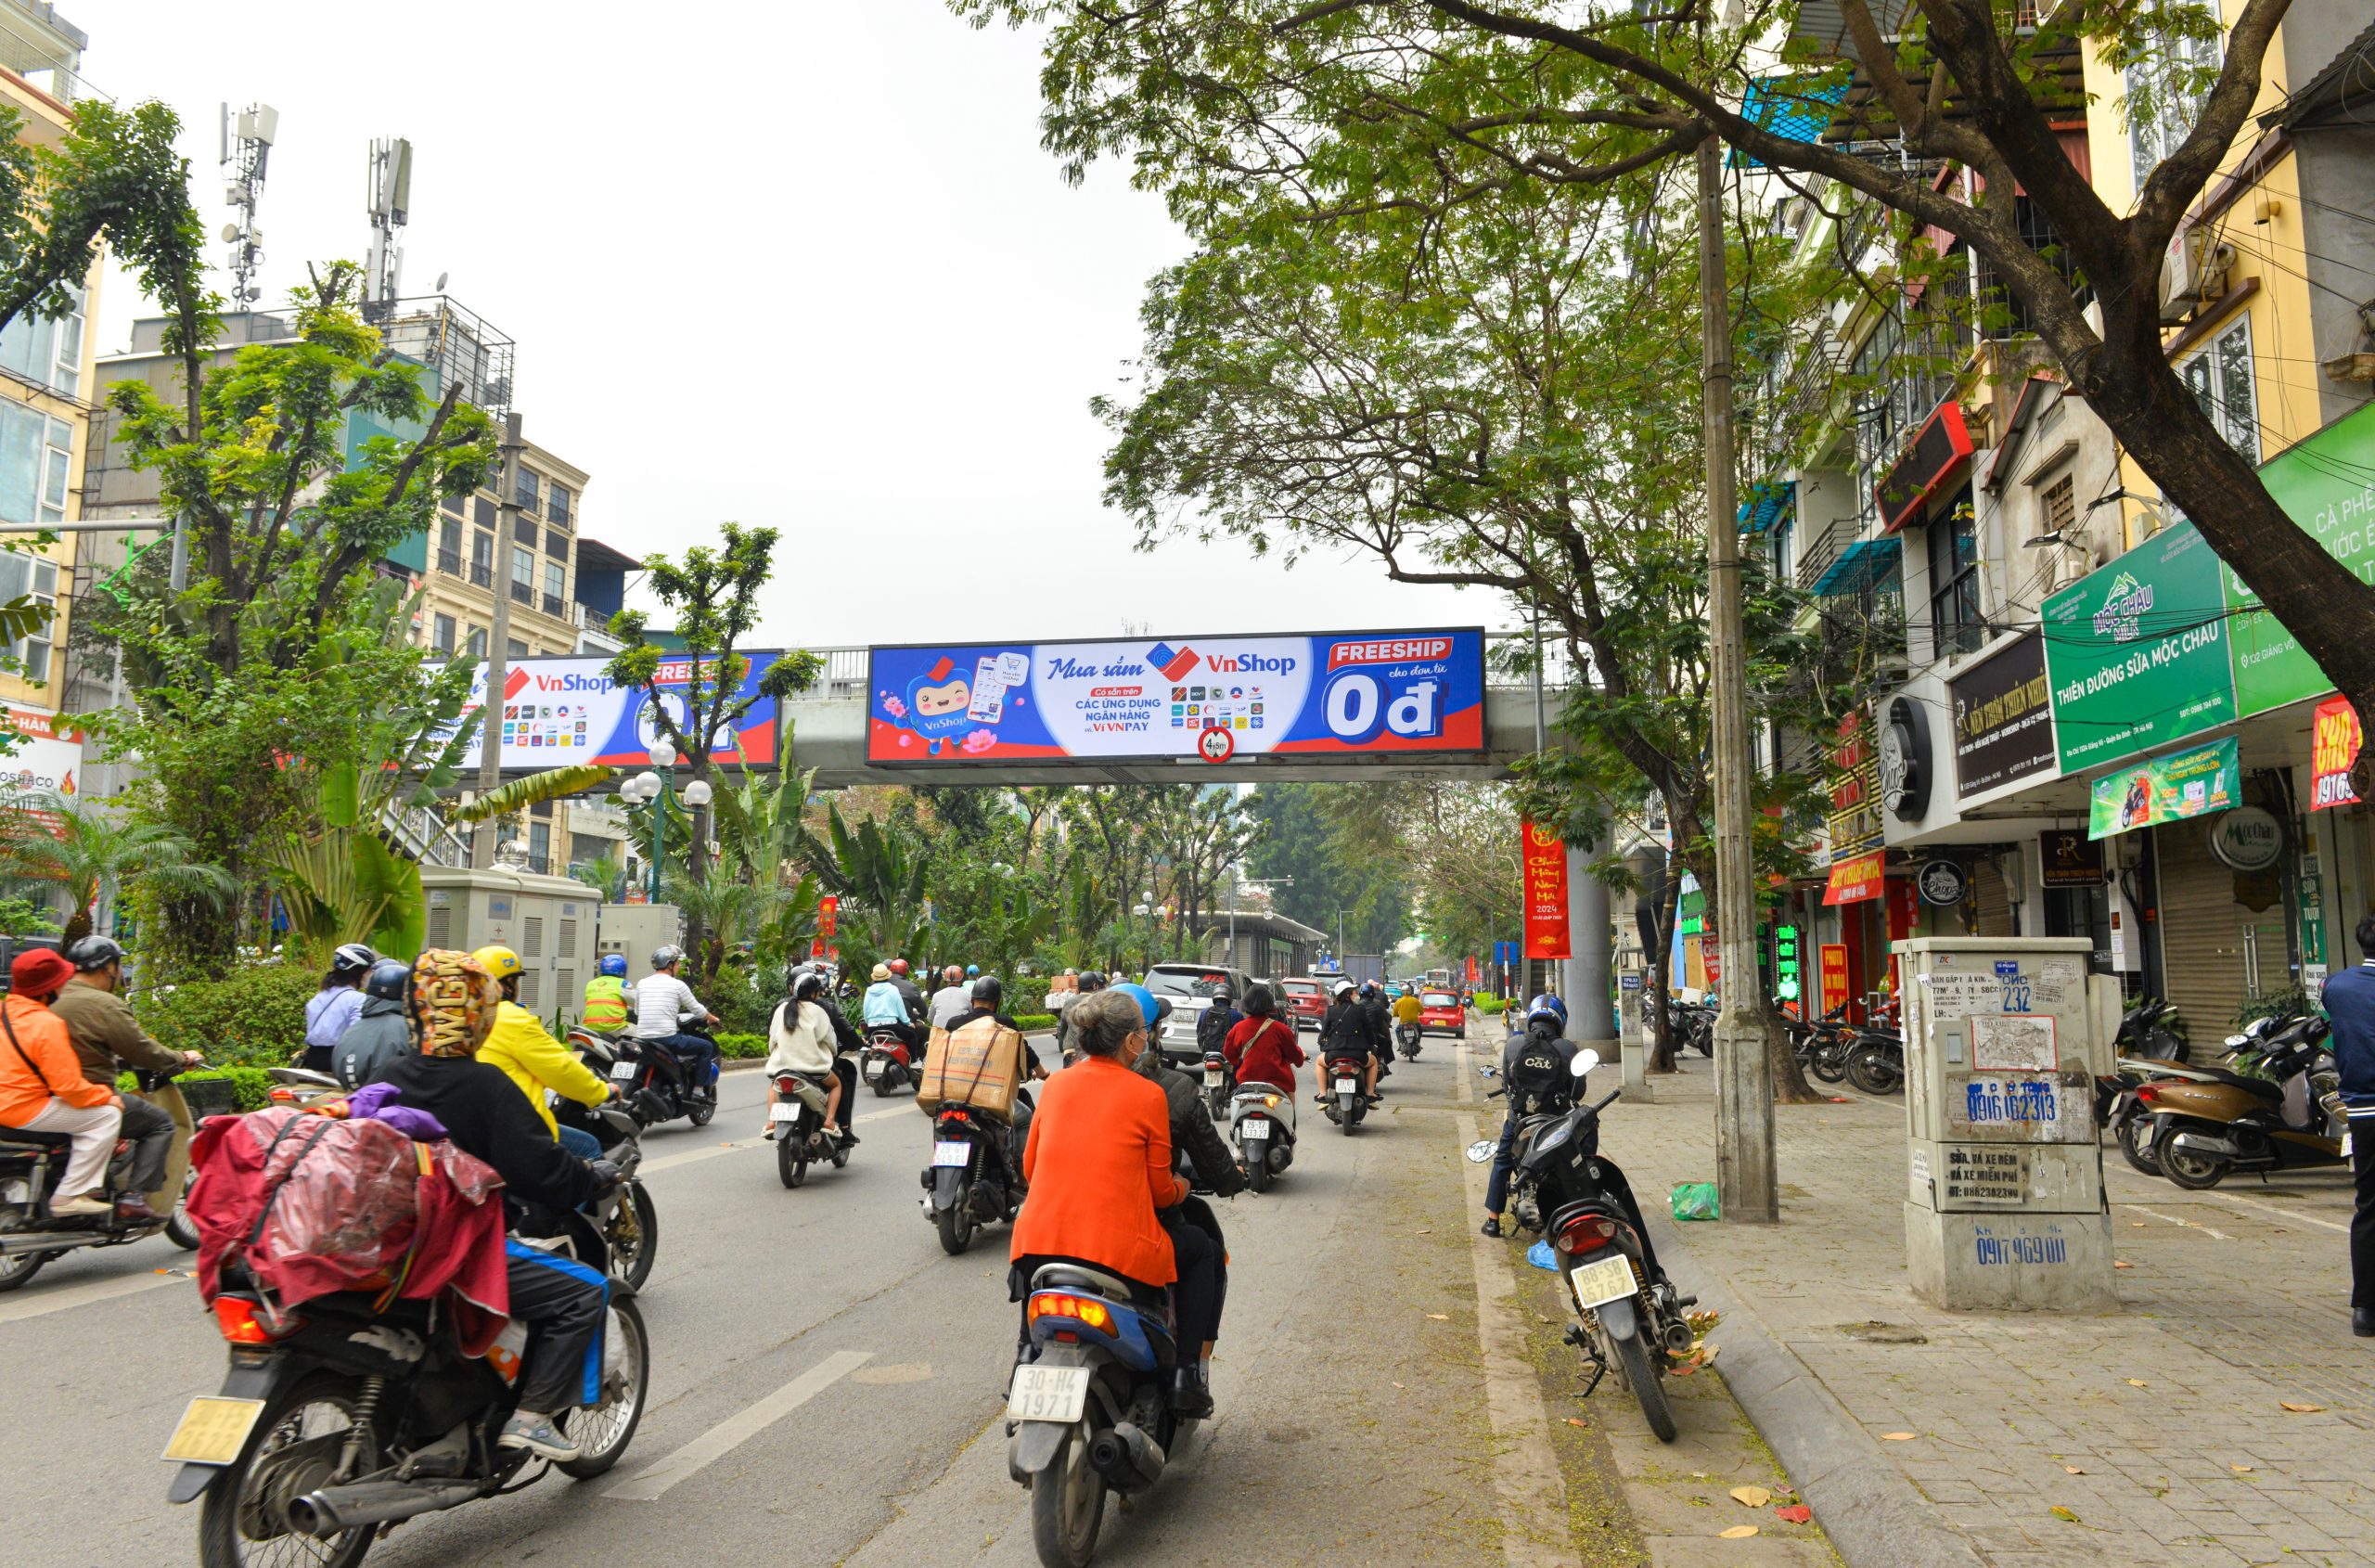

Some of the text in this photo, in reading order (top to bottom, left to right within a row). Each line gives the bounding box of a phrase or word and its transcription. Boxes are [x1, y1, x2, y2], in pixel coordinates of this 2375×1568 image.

[2316, 503, 2339, 534] CÀ
[2093, 603, 2119, 636] MỘC
[2120, 585, 2153, 621] CHÂU
[1336, 639, 1447, 662] FREESHIP
[1047, 657, 1098, 680] Mua
[1206, 654, 1296, 676] VnShop
[1389, 665, 1408, 678] cho
[2057, 679, 2086, 706] THIÊN
[2086, 662, 2125, 695] ĐƯỜNG
[2125, 651, 2150, 678] SỮA
[2151, 638, 2180, 669] MỘC
[536, 674, 614, 696] VnShop
[1076, 698, 1162, 711] CÁC ỨNG DỤNG
[2179, 709, 2190, 718] SĐT:
[2203, 700, 2212, 711] 194
[2212, 697, 2222, 707] 100
[1085, 710, 1150, 721] NGÂN HÀNG
[1107, 722, 1149, 732] VNPAY
[2317, 710, 2351, 774] CHO
[1528, 856, 1561, 867] Chúc
[1531, 867, 1560, 883] Mừng
[1534, 880, 1558, 890] Năm
[1536, 892, 1556, 902] Mới
[1536, 905, 1558, 913] 2024
[1825, 950, 1843, 966] PHOTO
[1825, 974, 1832, 989] IN
[2004, 986, 2032, 1013] 232
[1934, 1009, 1946, 1018] LH:
[1971, 1150, 1983, 1164] VÁ
[1985, 1154, 1997, 1164] XE
[1950, 1166, 1962, 1180] VÁ
[1963, 1170, 1975, 1180] XE
[2003, 1169, 2018, 1183] PHÍ
[1976, 1236, 2066, 1265] 0917 969 011
[1585, 1277, 1627, 1300] 5767
[1024, 1369, 1076, 1393] 30-H4
[1022, 1394, 1073, 1418] 1971
